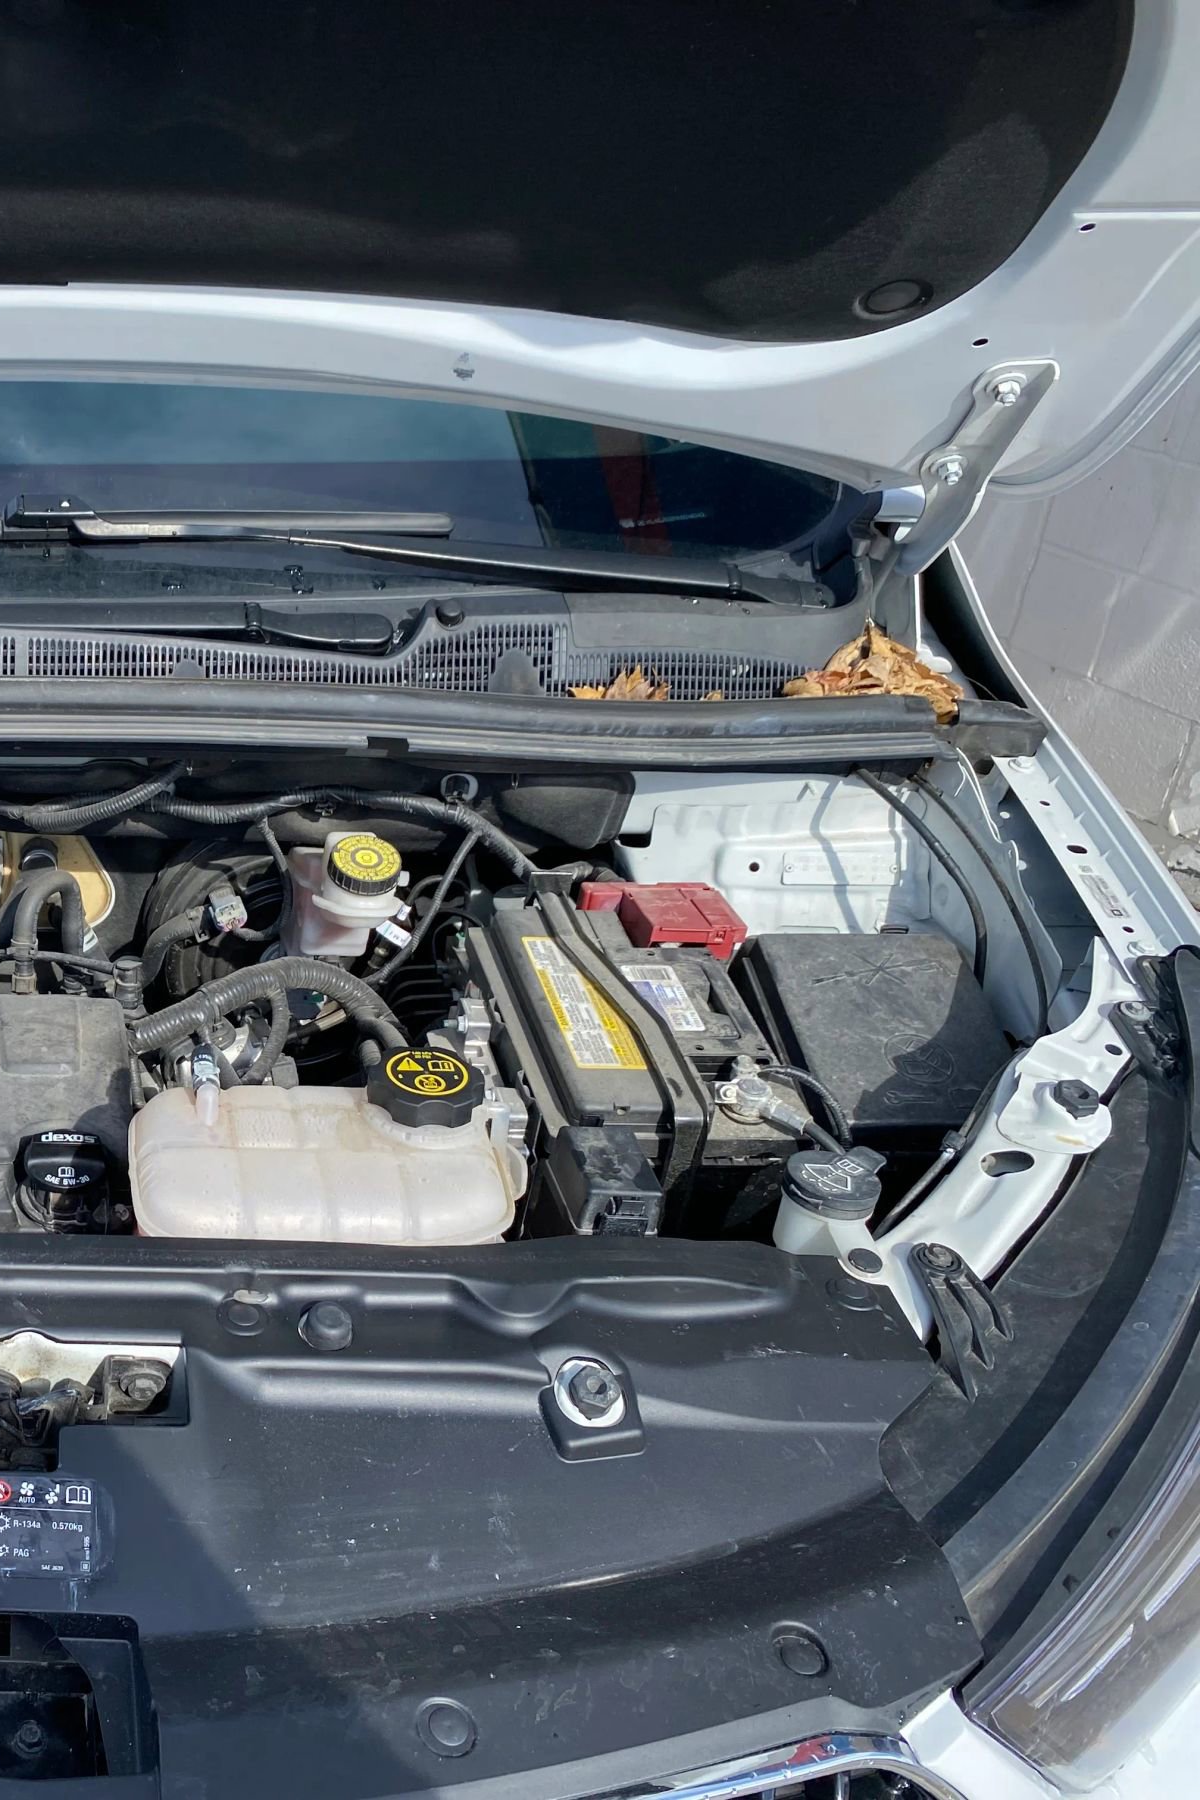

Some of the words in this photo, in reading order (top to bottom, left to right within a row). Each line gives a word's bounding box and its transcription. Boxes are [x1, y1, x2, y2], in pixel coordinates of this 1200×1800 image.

[41, 1131, 98, 1143] dexos
[44, 1174, 61, 1185] SAE
[18, 1496, 36, 1504] AUTO
[13, 1519, 41, 1529] R-134a
[51, 1521, 83, 1533] 0.570kg
[13, 1548, 30, 1558] PAG
